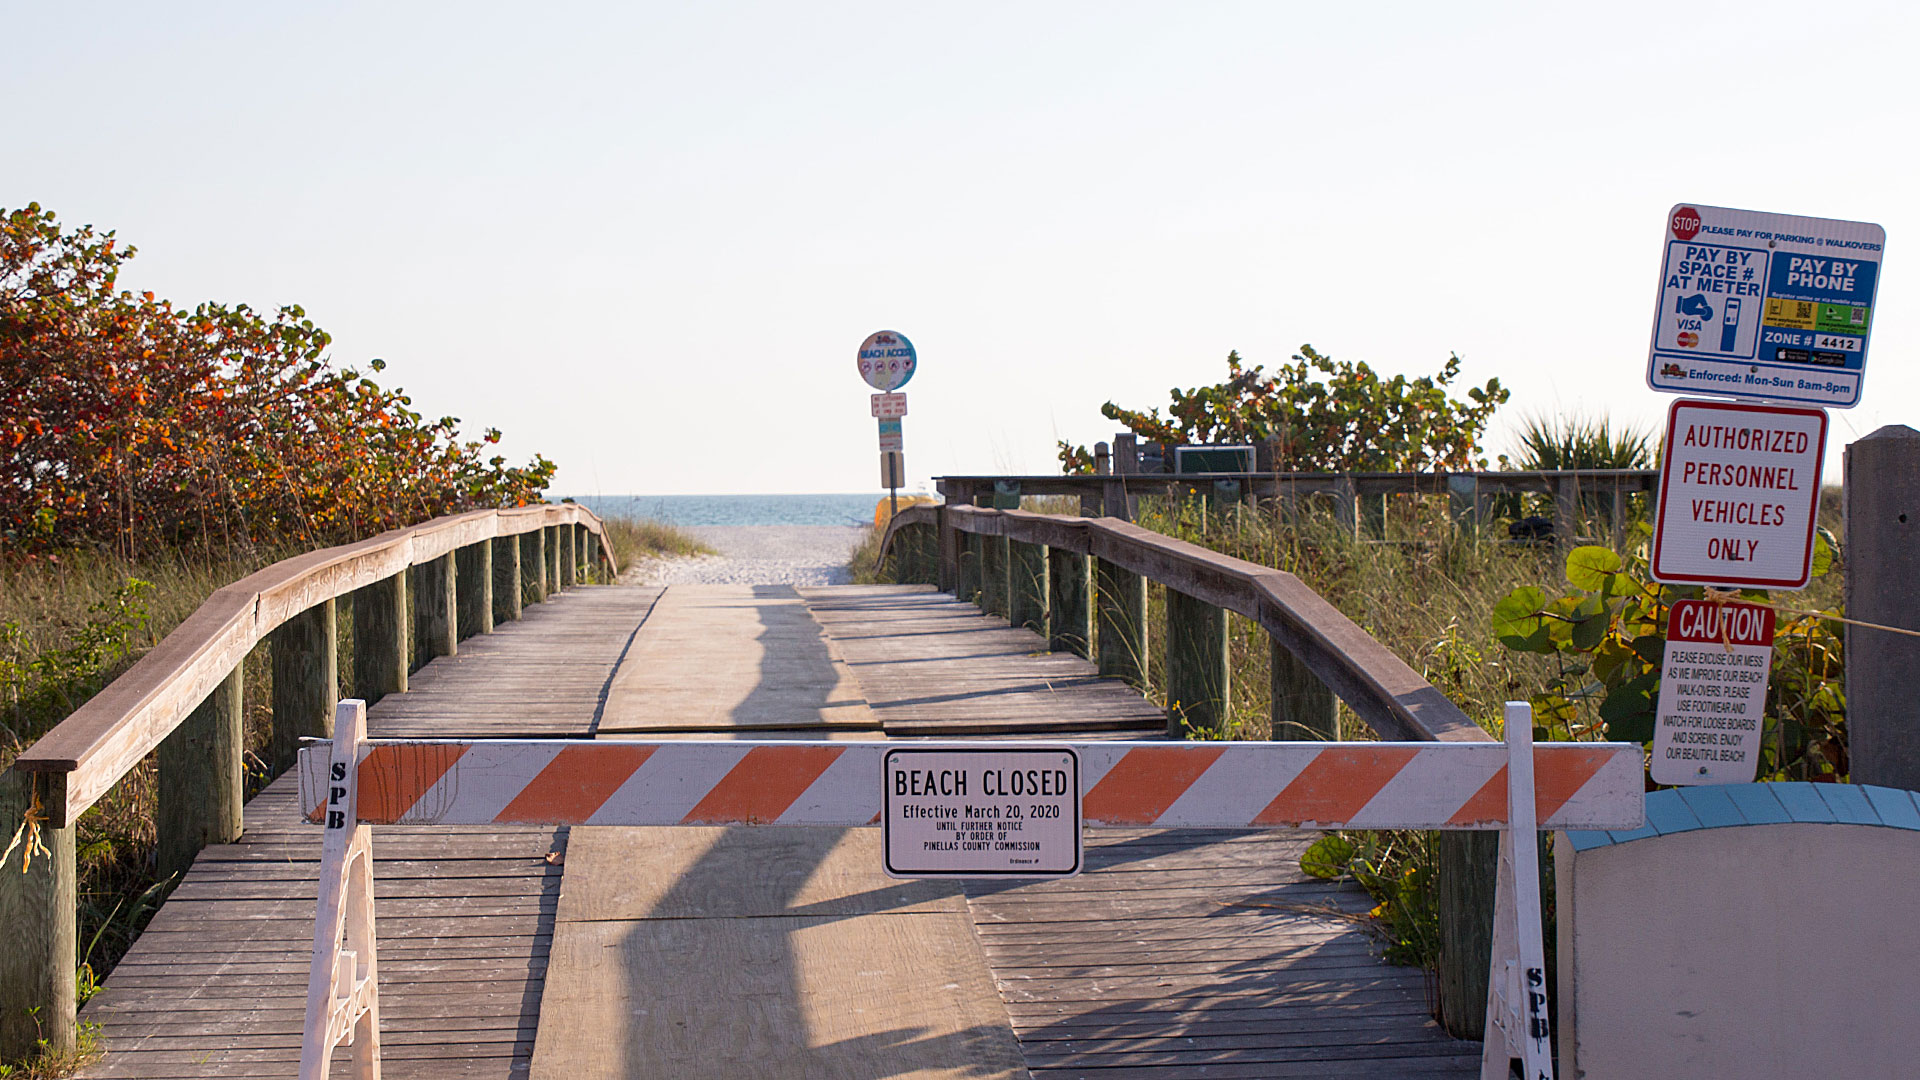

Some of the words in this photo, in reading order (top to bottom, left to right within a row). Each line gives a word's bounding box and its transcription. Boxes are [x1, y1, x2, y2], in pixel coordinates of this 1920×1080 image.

[1673, 217, 1699, 231] STOP
[1701, 225, 1735, 236] PLEASE
[1736, 229, 1753, 238] PAY
[1754, 231, 1772, 240] FOR
[1774, 233, 1815, 244] PARKING
[1825, 239, 1882, 251] WALKOVERS
[1686, 246, 1721, 262] PAY
[1725, 250, 1752, 266] BY
[1678, 261, 1738, 280] SPACE
[1743, 267, 1754, 281] #
[1789, 257, 1827, 274] PAY
[1831, 261, 1859, 277] BY
[1667, 275, 1692, 289] AT
[1696, 278, 1760, 297] METER
[1787, 272, 1856, 292] PHONE
[1676, 319, 1702, 331] VISA
[1764, 332, 1801, 345] ZONE
[1803, 335, 1812, 346] #
[1821, 337, 1854, 350] 4412
[861, 349, 885, 359] BEACH
[1689, 369, 1742, 383] Enforced:
[1744, 375, 1794, 388] Mon-Sun
[1797, 379, 1850, 394] 8am-8pm
[1684, 425, 1809, 454] AUTHORIZED
[1683, 461, 1799, 491] PERSONNEL
[1691, 499, 1785, 527] VEHICLES
[1708, 538, 1759, 562] ONLY
[1679, 604, 1766, 642] CAUTION
[1671, 650, 1698, 664] PLEASE
[1699, 652, 1727, 666] EXCUSE
[1727, 653, 1743, 666] OUR
[1743, 655, 1764, 667] MESS
[1667, 667, 1678, 679] AS
[1679, 667, 1690, 680] WE
[1691, 668, 1722, 681] IMPROVE
[1723, 669, 1738, 682] OUR
[1739, 670, 1764, 683] BEACH
[1676, 684, 1722, 697] WALK-OVERS.
[1723, 686, 1751, 698] PLEASE
[1676, 700, 1691, 712] USE
[1692, 700, 1731, 713] FOOTWEAR
[1731, 702, 1746, 714] AND
[1663, 715, 1687, 728] WATCH
[1687, 716, 1702, 728] FOR
[1702, 717, 1727, 729] LOOSE
[1727, 718, 1756, 731] BOARDS
[1672, 731, 1687, 743] AND
[1687, 732, 1718, 745] SCREWS.
[1720, 733, 1744, 746] ENJOY
[1666, 747, 1681, 759] OUR
[1682, 748, 1718, 761] BEAUTIFUL
[895, 770, 967, 796] BEACH
[983, 770, 1067, 796] CLOSED
[328, 762, 347, 829] SPB
[903, 804, 958, 819] Effective
[965, 804, 1000, 819] March
[1005, 804, 1024, 821] 20,
[1030, 804, 1060, 819] 2020
[936, 821, 957, 831] UNTIL
[961, 821, 993, 831] FURTHER
[997, 821, 1023, 831] NOTICE
[956, 831, 966, 841] BY
[970, 831, 994, 841] ORDER
[998, 831, 1007, 841] OF
[924, 841, 958, 851] PINELLAS
[962, 841, 990, 851] COUNTY
[994, 841, 1040, 851] COMMISSION
